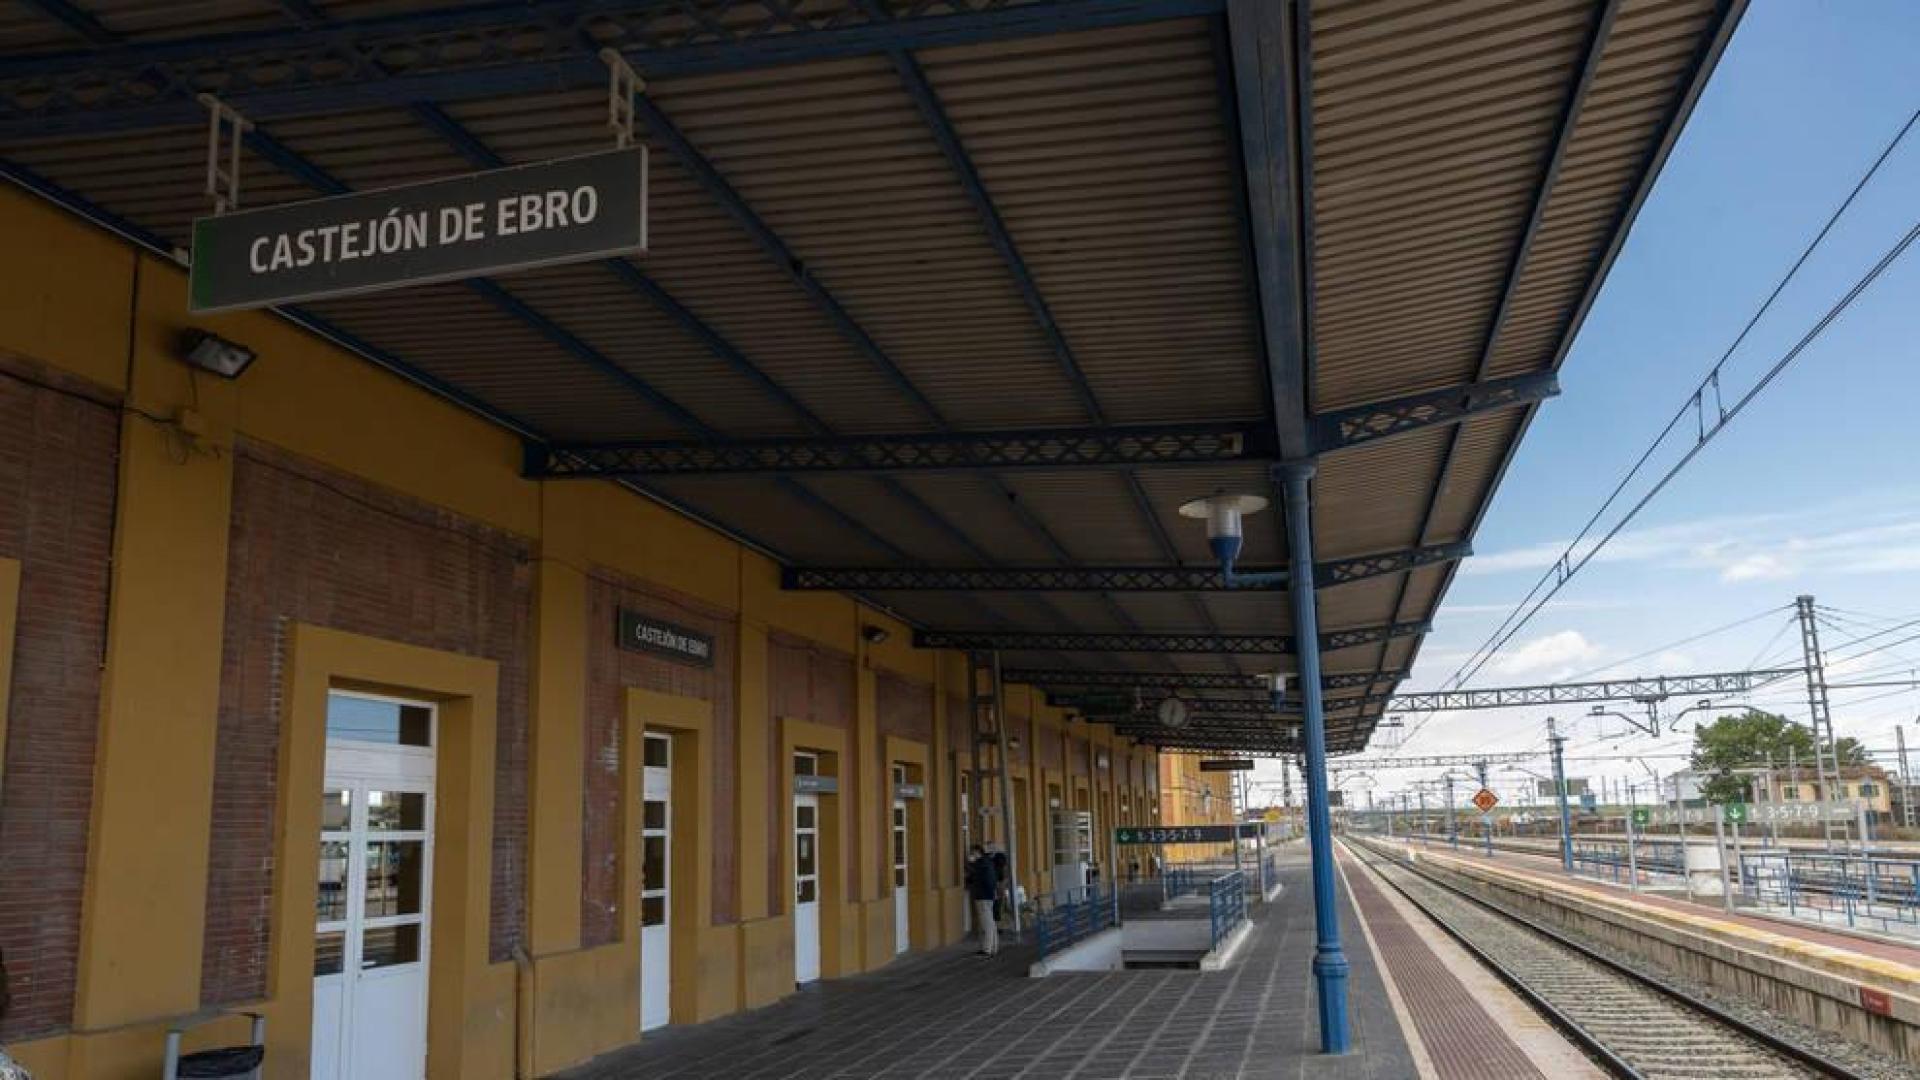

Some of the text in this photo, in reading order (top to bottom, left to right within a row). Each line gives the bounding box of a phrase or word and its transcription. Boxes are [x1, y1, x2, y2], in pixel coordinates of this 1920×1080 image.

[249, 185, 598, 274] CASTEJÓN DE EBRO
